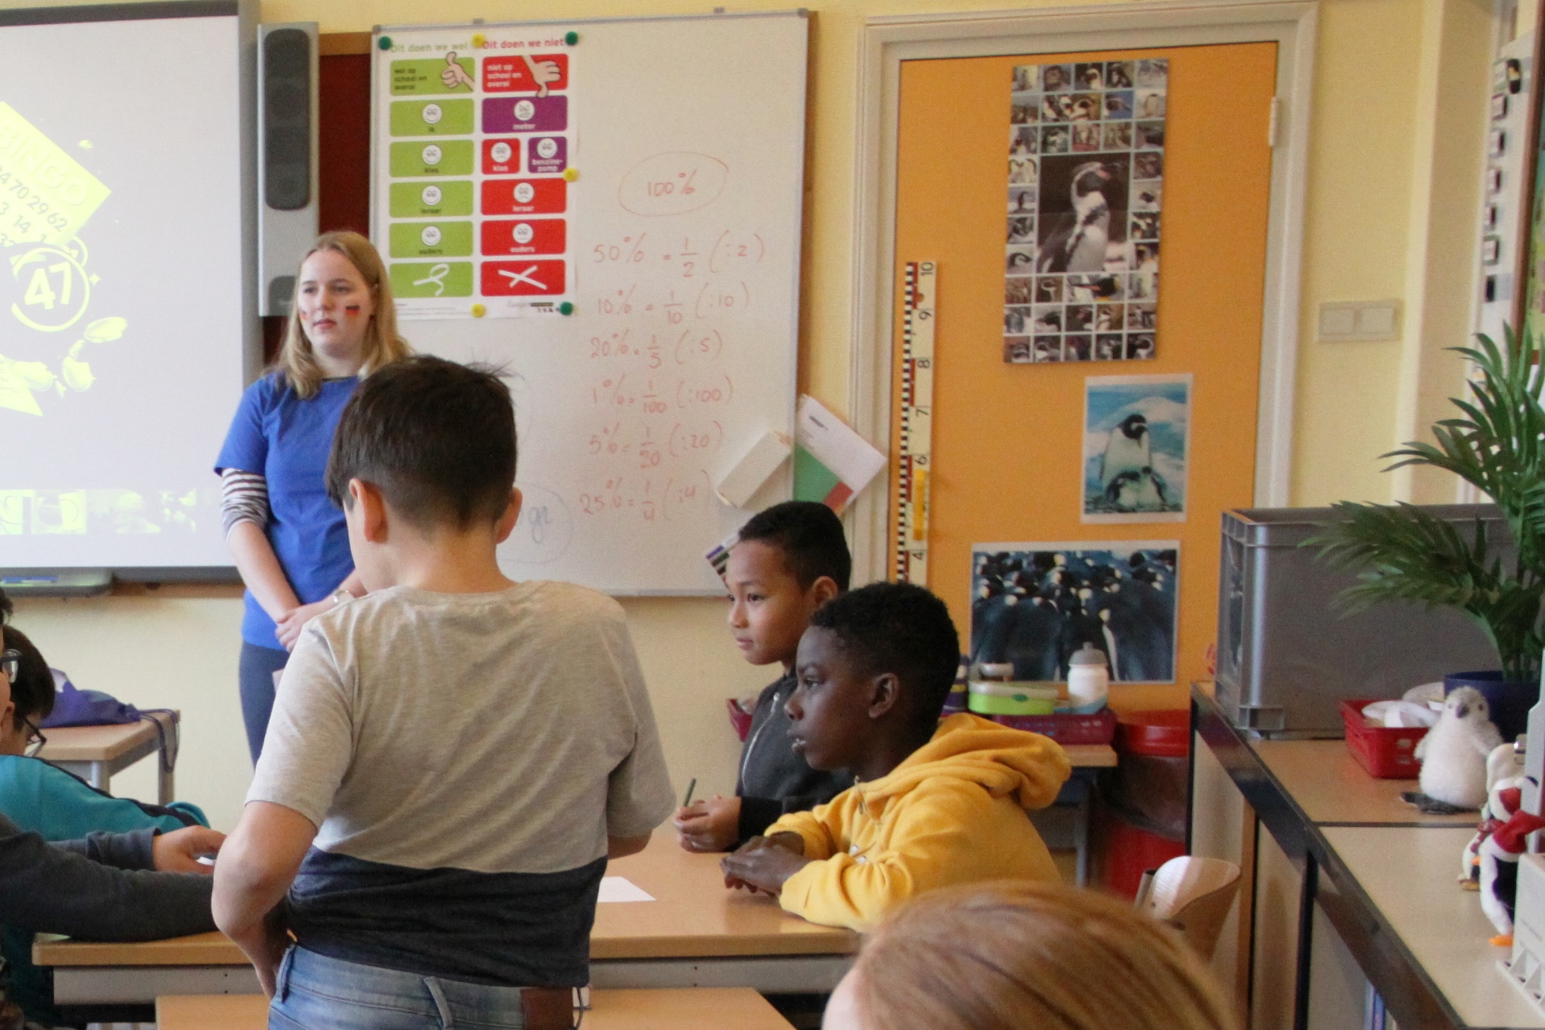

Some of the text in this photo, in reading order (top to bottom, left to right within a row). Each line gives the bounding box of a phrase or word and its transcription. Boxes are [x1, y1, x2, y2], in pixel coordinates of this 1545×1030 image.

[408, 43, 432, 52] doen
[500, 39, 525, 49] doen
[527, 40, 541, 48] we
[544, 38, 564, 47] niet
[487, 63, 502, 71] niet
[647, 168, 698, 197] 100%
[8, 178, 30, 199] 70
[26, 195, 49, 215] 29
[47, 212, 67, 232] 62
[593, 231, 647, 263] 50%
[24, 261, 72, 310] 47
